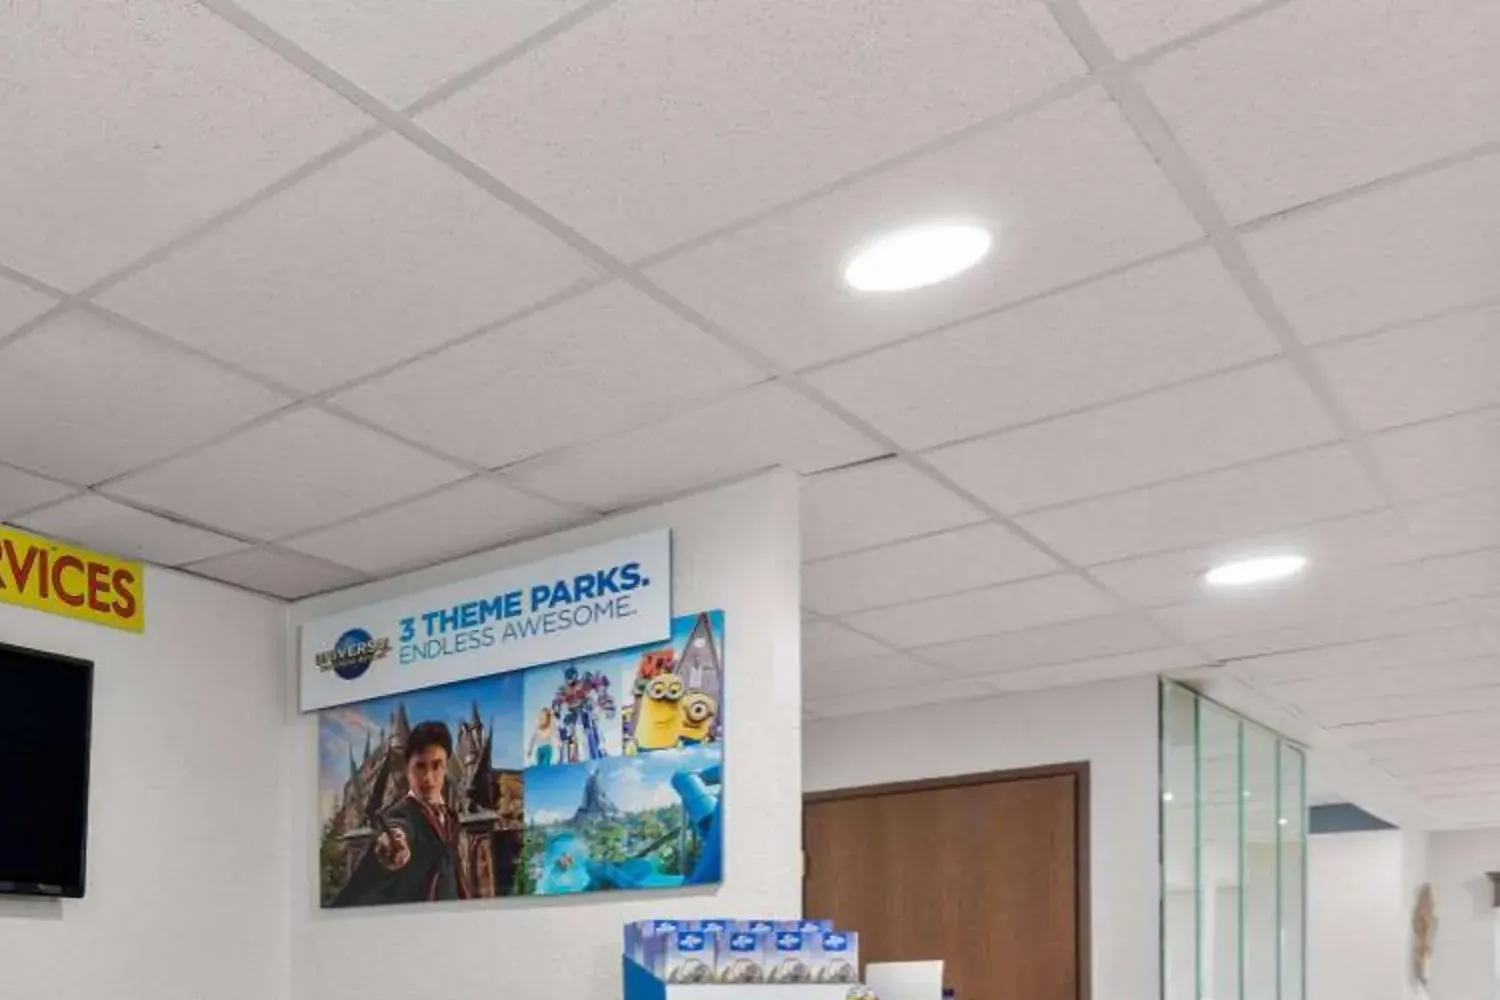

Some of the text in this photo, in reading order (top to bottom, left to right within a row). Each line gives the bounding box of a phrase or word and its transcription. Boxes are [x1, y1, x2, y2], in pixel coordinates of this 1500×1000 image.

[399, 562, 651, 643] 3 THEME PARKS.
[399, 627, 495, 665] ENDLESS
[502, 595, 638, 643] AWESOME.
